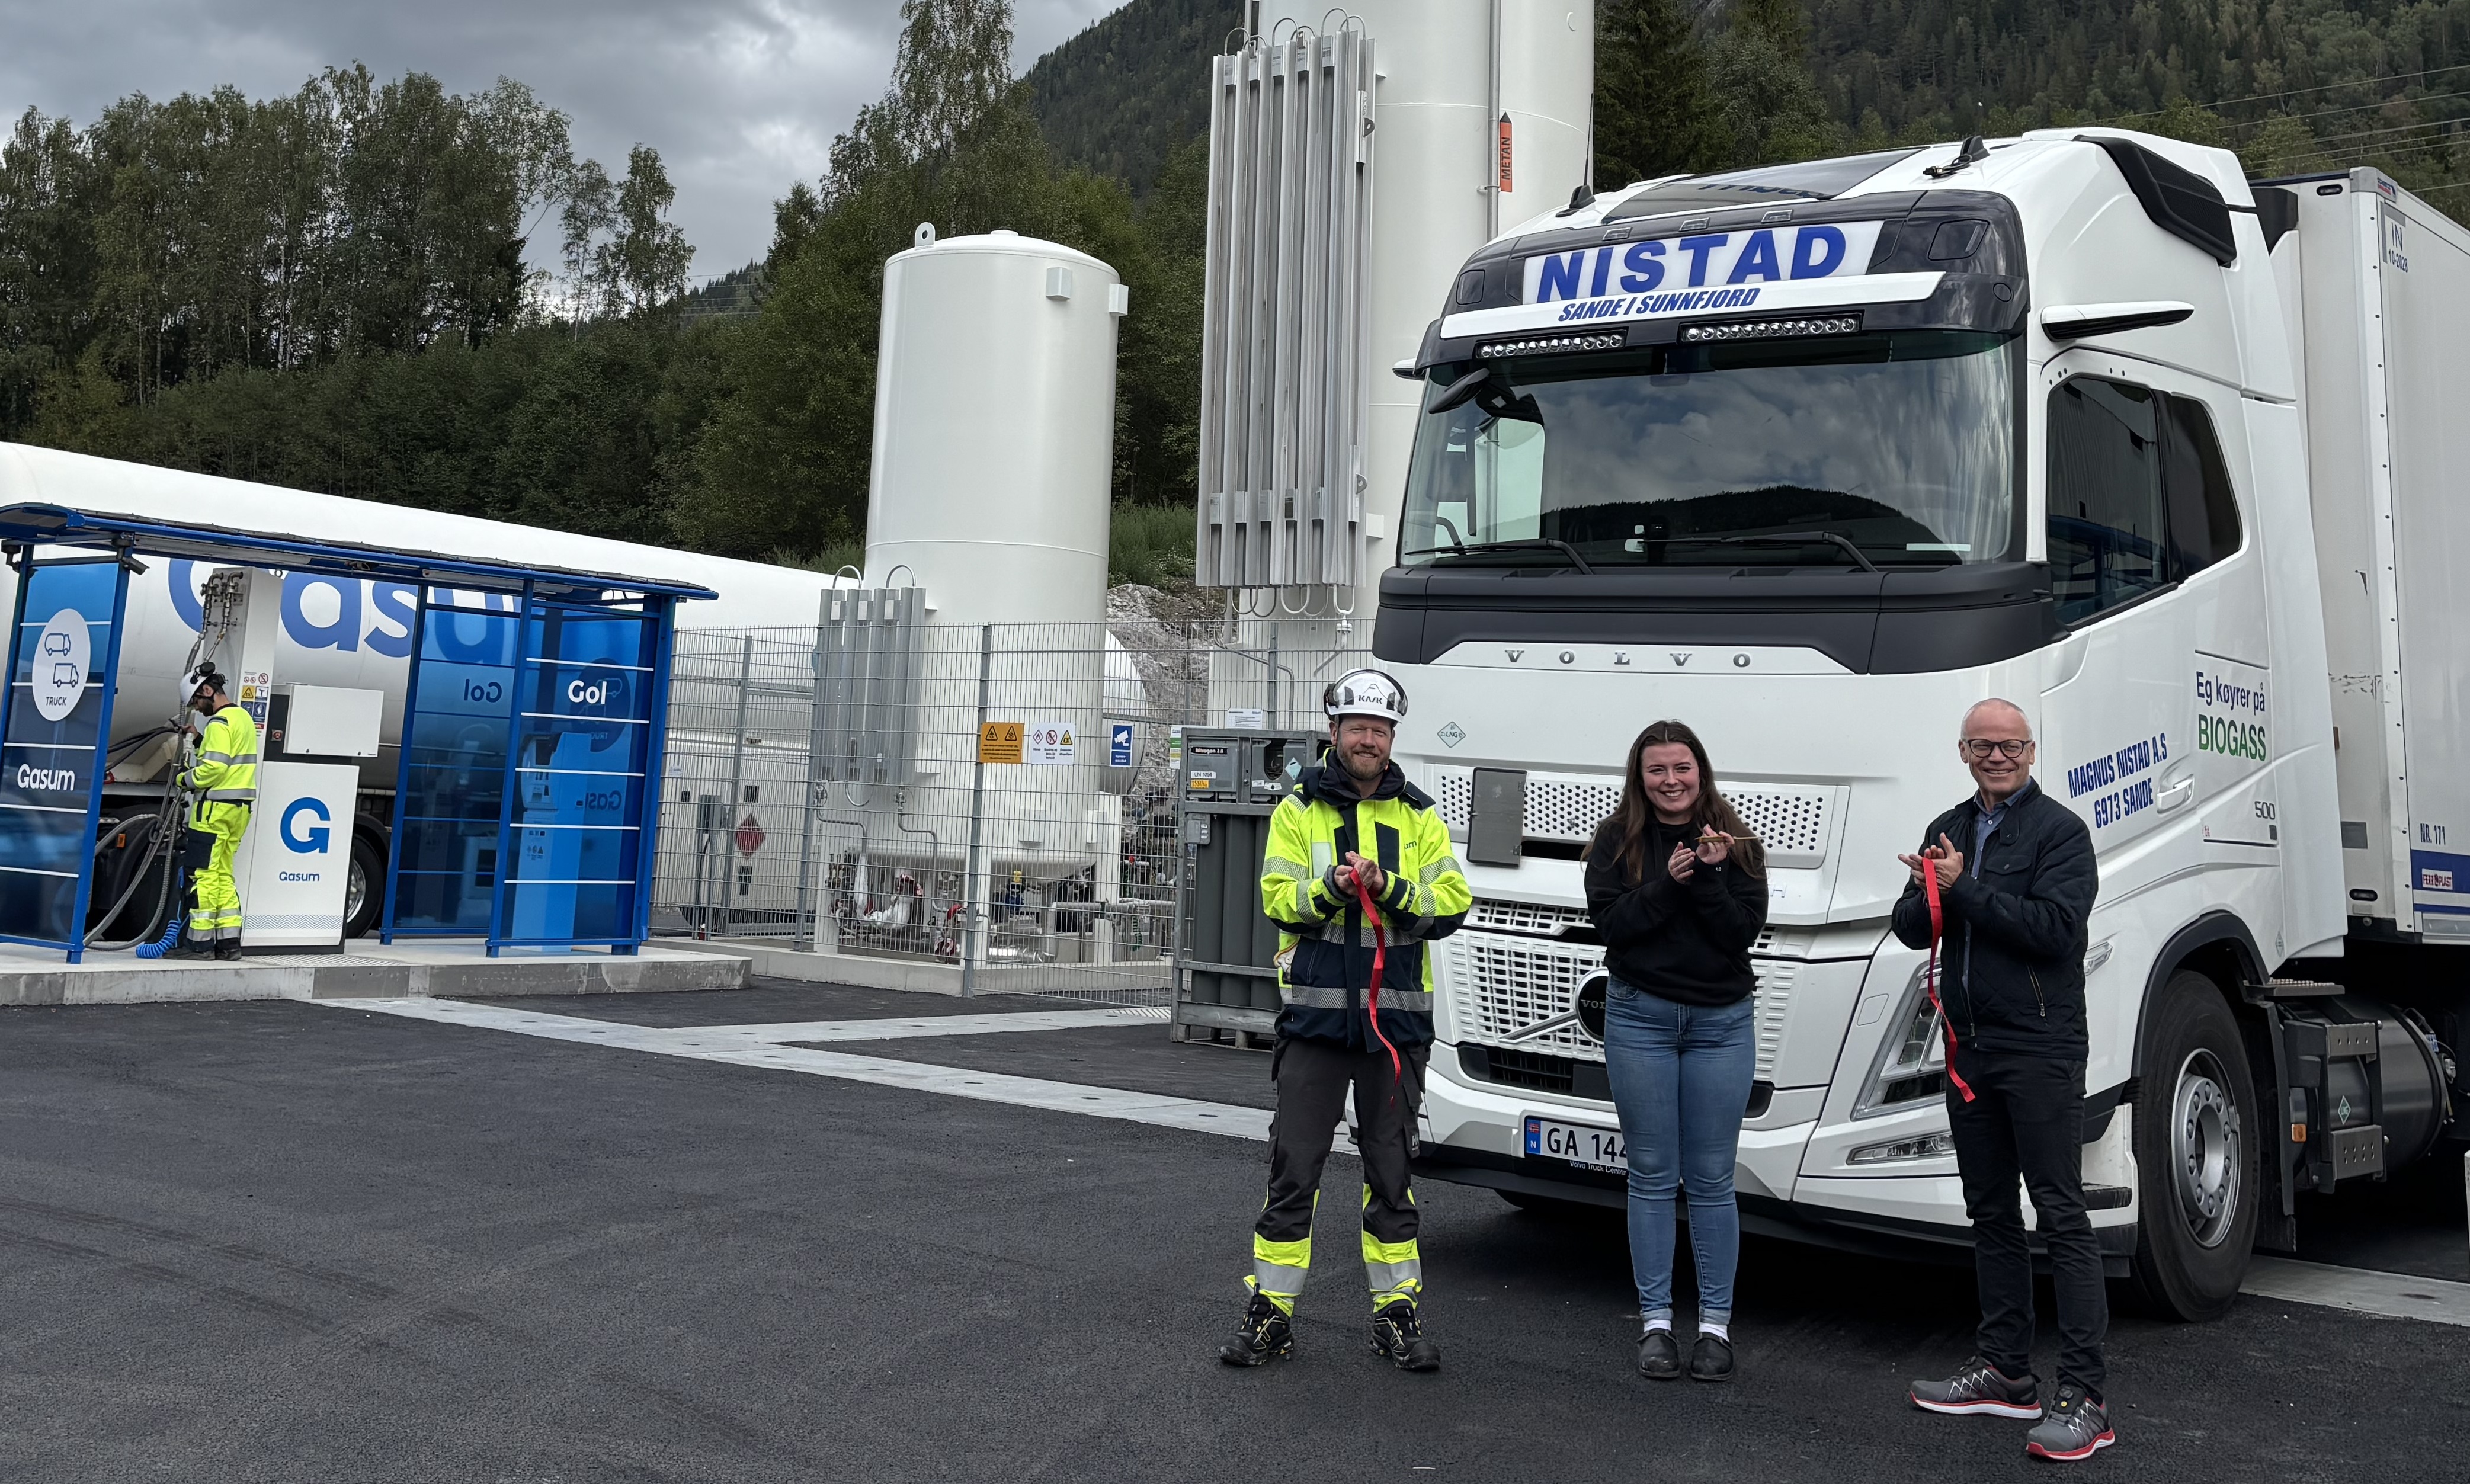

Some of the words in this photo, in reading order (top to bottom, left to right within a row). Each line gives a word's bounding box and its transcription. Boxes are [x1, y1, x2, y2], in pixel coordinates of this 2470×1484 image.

[1501, 137, 1511, 180] METAN
[1537, 226, 1846, 303] NISTAD
[1558, 297, 1623, 322] SANDE
[1624, 296, 1635, 315] I
[1636, 288, 1761, 315] SUNNFJORD
[1505, 649, 1751, 668] VOLVO
[46, 697, 67, 706] TRUCK
[568, 680, 607, 704] Gol
[2196, 671, 2212, 706] Eg
[2216, 675, 2250, 711] køyrer
[2253, 682, 2265, 716] på
[2199, 714, 2266, 761] BIOGASS
[17, 764, 75, 791] Gasum
[2068, 754, 2115, 799] MAGNUS
[2116, 740, 2150, 779] NISTAD
[2094, 792, 2121, 829] 6973
[2123, 777, 2154, 816] SANDE
[2254, 801, 2275, 820] 500
[2434, 825, 2446, 846] 171
[279, 871, 320, 882] Gasum
[1547, 1127, 1579, 1156] GA
[1570, 1161, 1586, 1169] Volvo
[1588, 1163, 1604, 1172] Truck
